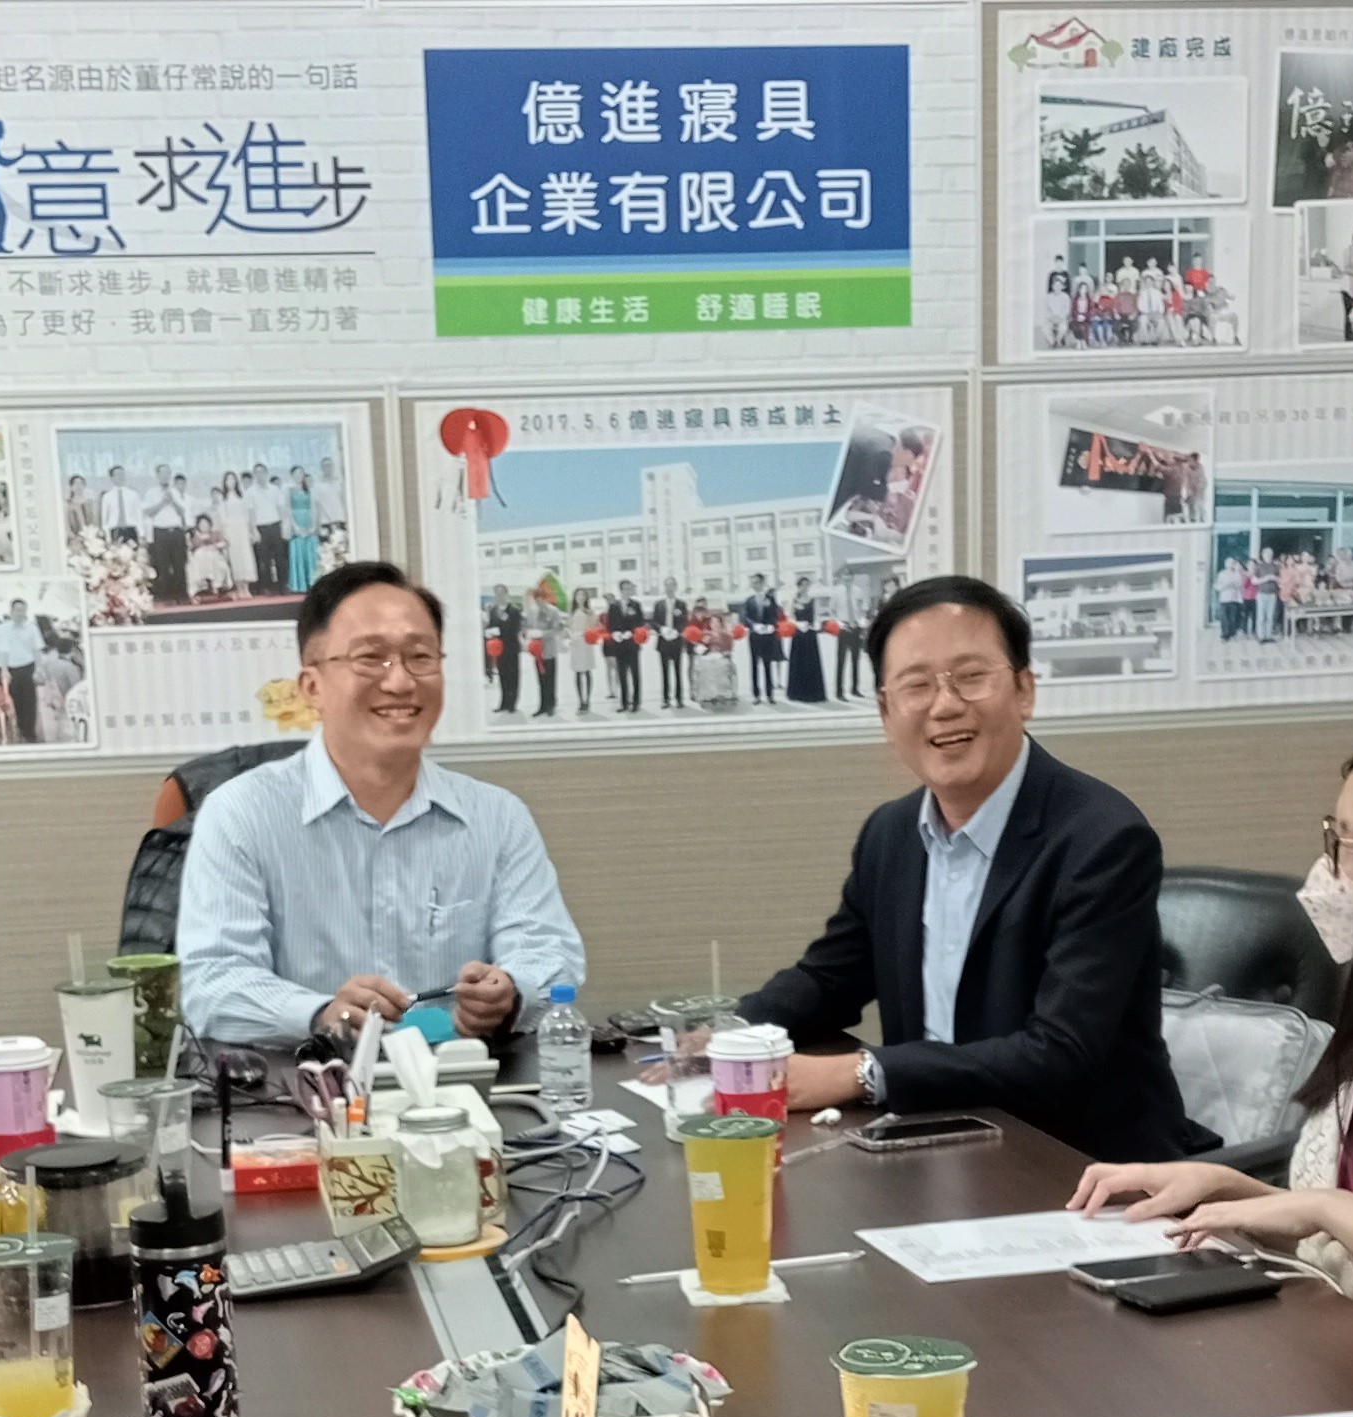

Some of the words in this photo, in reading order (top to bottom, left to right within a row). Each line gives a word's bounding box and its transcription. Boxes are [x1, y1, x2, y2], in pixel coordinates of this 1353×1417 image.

[1131, 36, 1233, 60] 建廠完成
[521, 79, 817, 145] 億進寢具
[469, 168, 872, 236] 企業有限公司
[521, 296, 650, 326] 健康生活
[696, 291, 822, 322] 舒適睡眠
